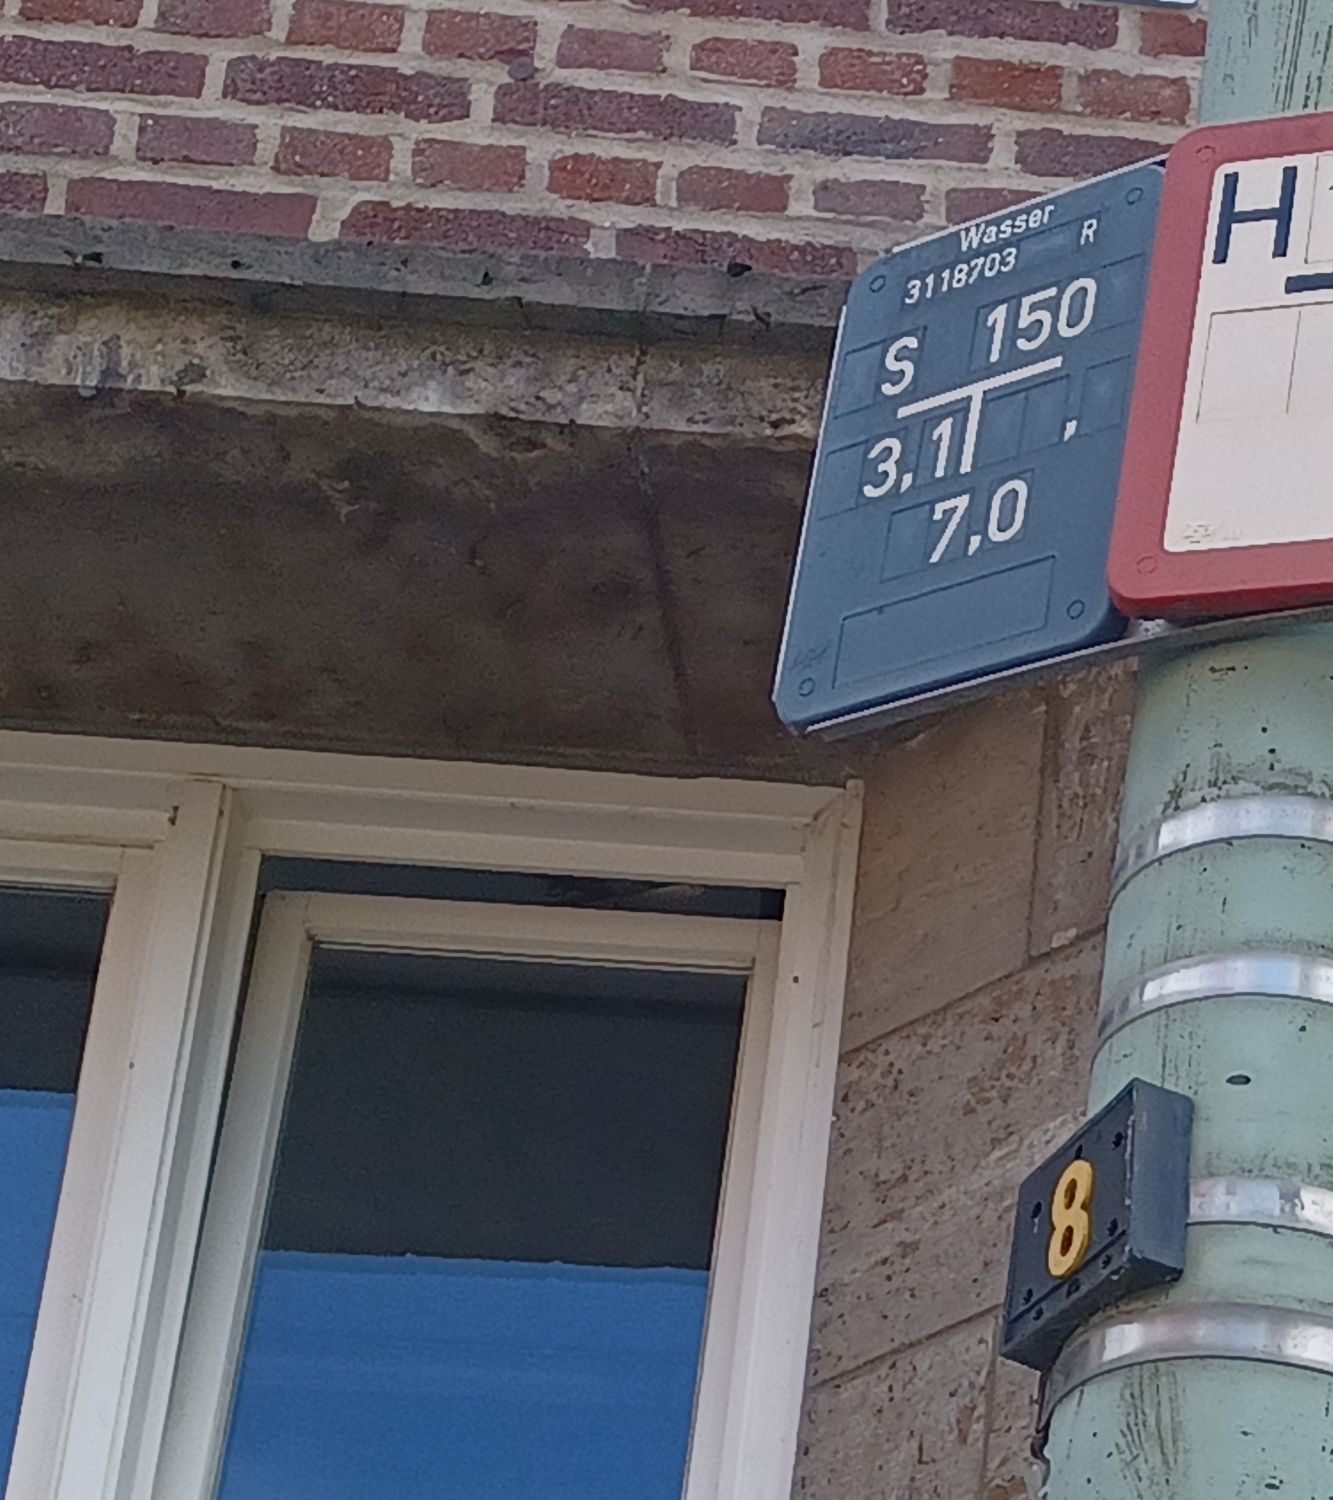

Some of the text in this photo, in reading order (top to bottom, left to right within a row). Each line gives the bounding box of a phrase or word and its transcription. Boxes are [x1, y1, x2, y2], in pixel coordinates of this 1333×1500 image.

[959, 200, 1054, 253] Wasser
[1079, 218, 1098, 246] R
[904, 246, 1017, 304] 3118703
[985, 276, 1098, 364] 150
[881, 335, 919, 397] S
[1048, 1159, 1093, 1280] 8
